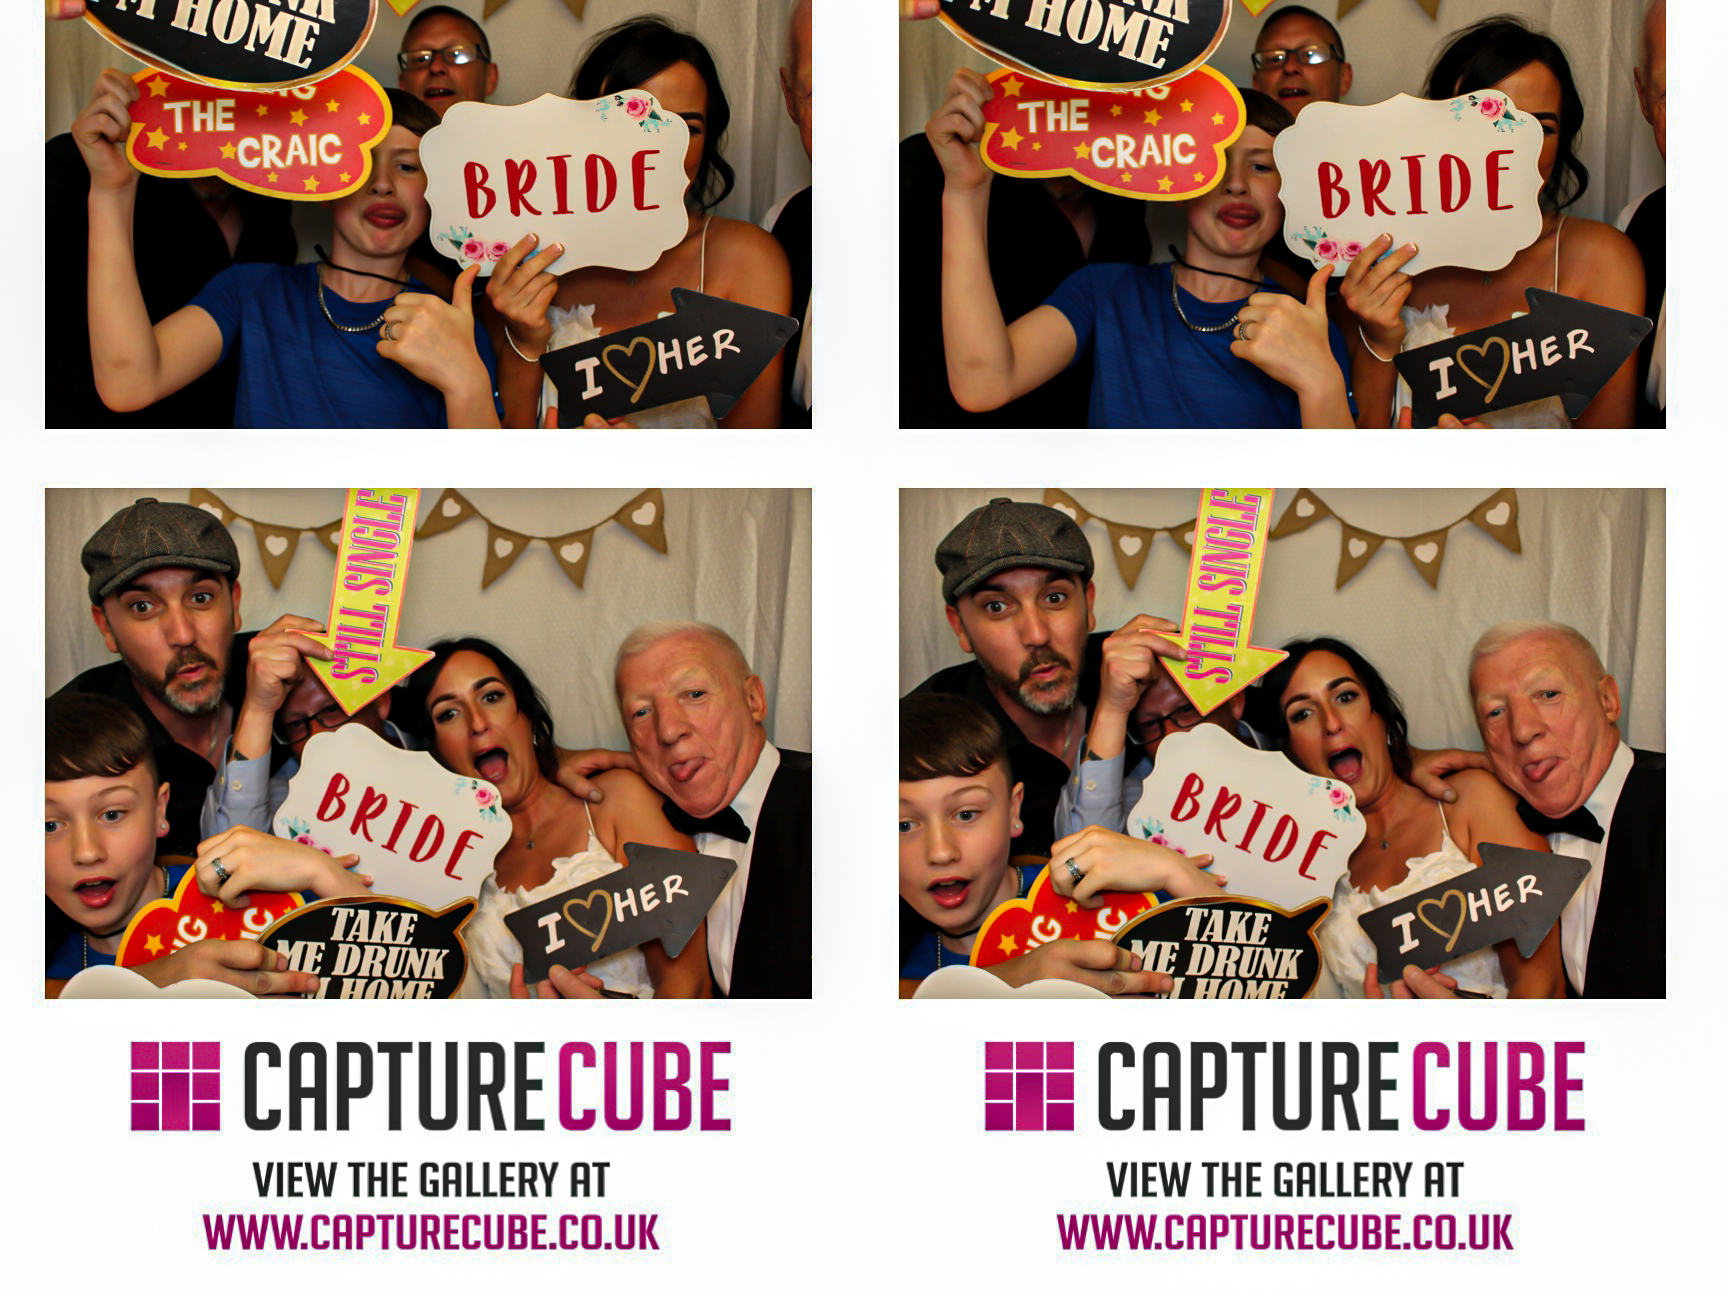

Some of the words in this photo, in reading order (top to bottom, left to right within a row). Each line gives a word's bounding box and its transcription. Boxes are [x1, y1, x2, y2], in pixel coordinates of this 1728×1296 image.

[163, 98, 236, 133] THE
[237, 133, 343, 169] CRAIC
[1017, 98, 1090, 133] THE
[1091, 133, 1197, 169] CRAIC
[464, 150, 660, 219] BRIDE
[1318, 150, 1514, 219] BRIDE
[575, 356, 603, 401] I
[658, 328, 741, 374] HER
[1429, 356, 1457, 401] I
[1512, 328, 1595, 374] HER
[344, 488, 408, 596] SINGLE
[1198, 488, 1262, 596] SINGLE
[331, 603, 390, 684] STILL
[1185, 603, 1244, 684] STILL
[316, 773, 484, 880] BRIDE
[1170, 773, 1338, 880] BRIDE
[330, 907, 418, 946] TAKE
[537, 912, 566, 954] I
[613, 874, 689, 922] HER
[1184, 907, 1272, 946] TAKE
[1391, 912, 1420, 954] I
[1467, 874, 1543, 922] HER
[276, 939, 326, 975] ME
[331, 943, 450, 980] DRUNK
[1130, 939, 1180, 975] ME
[1185, 943, 1304, 980] DRUNK
